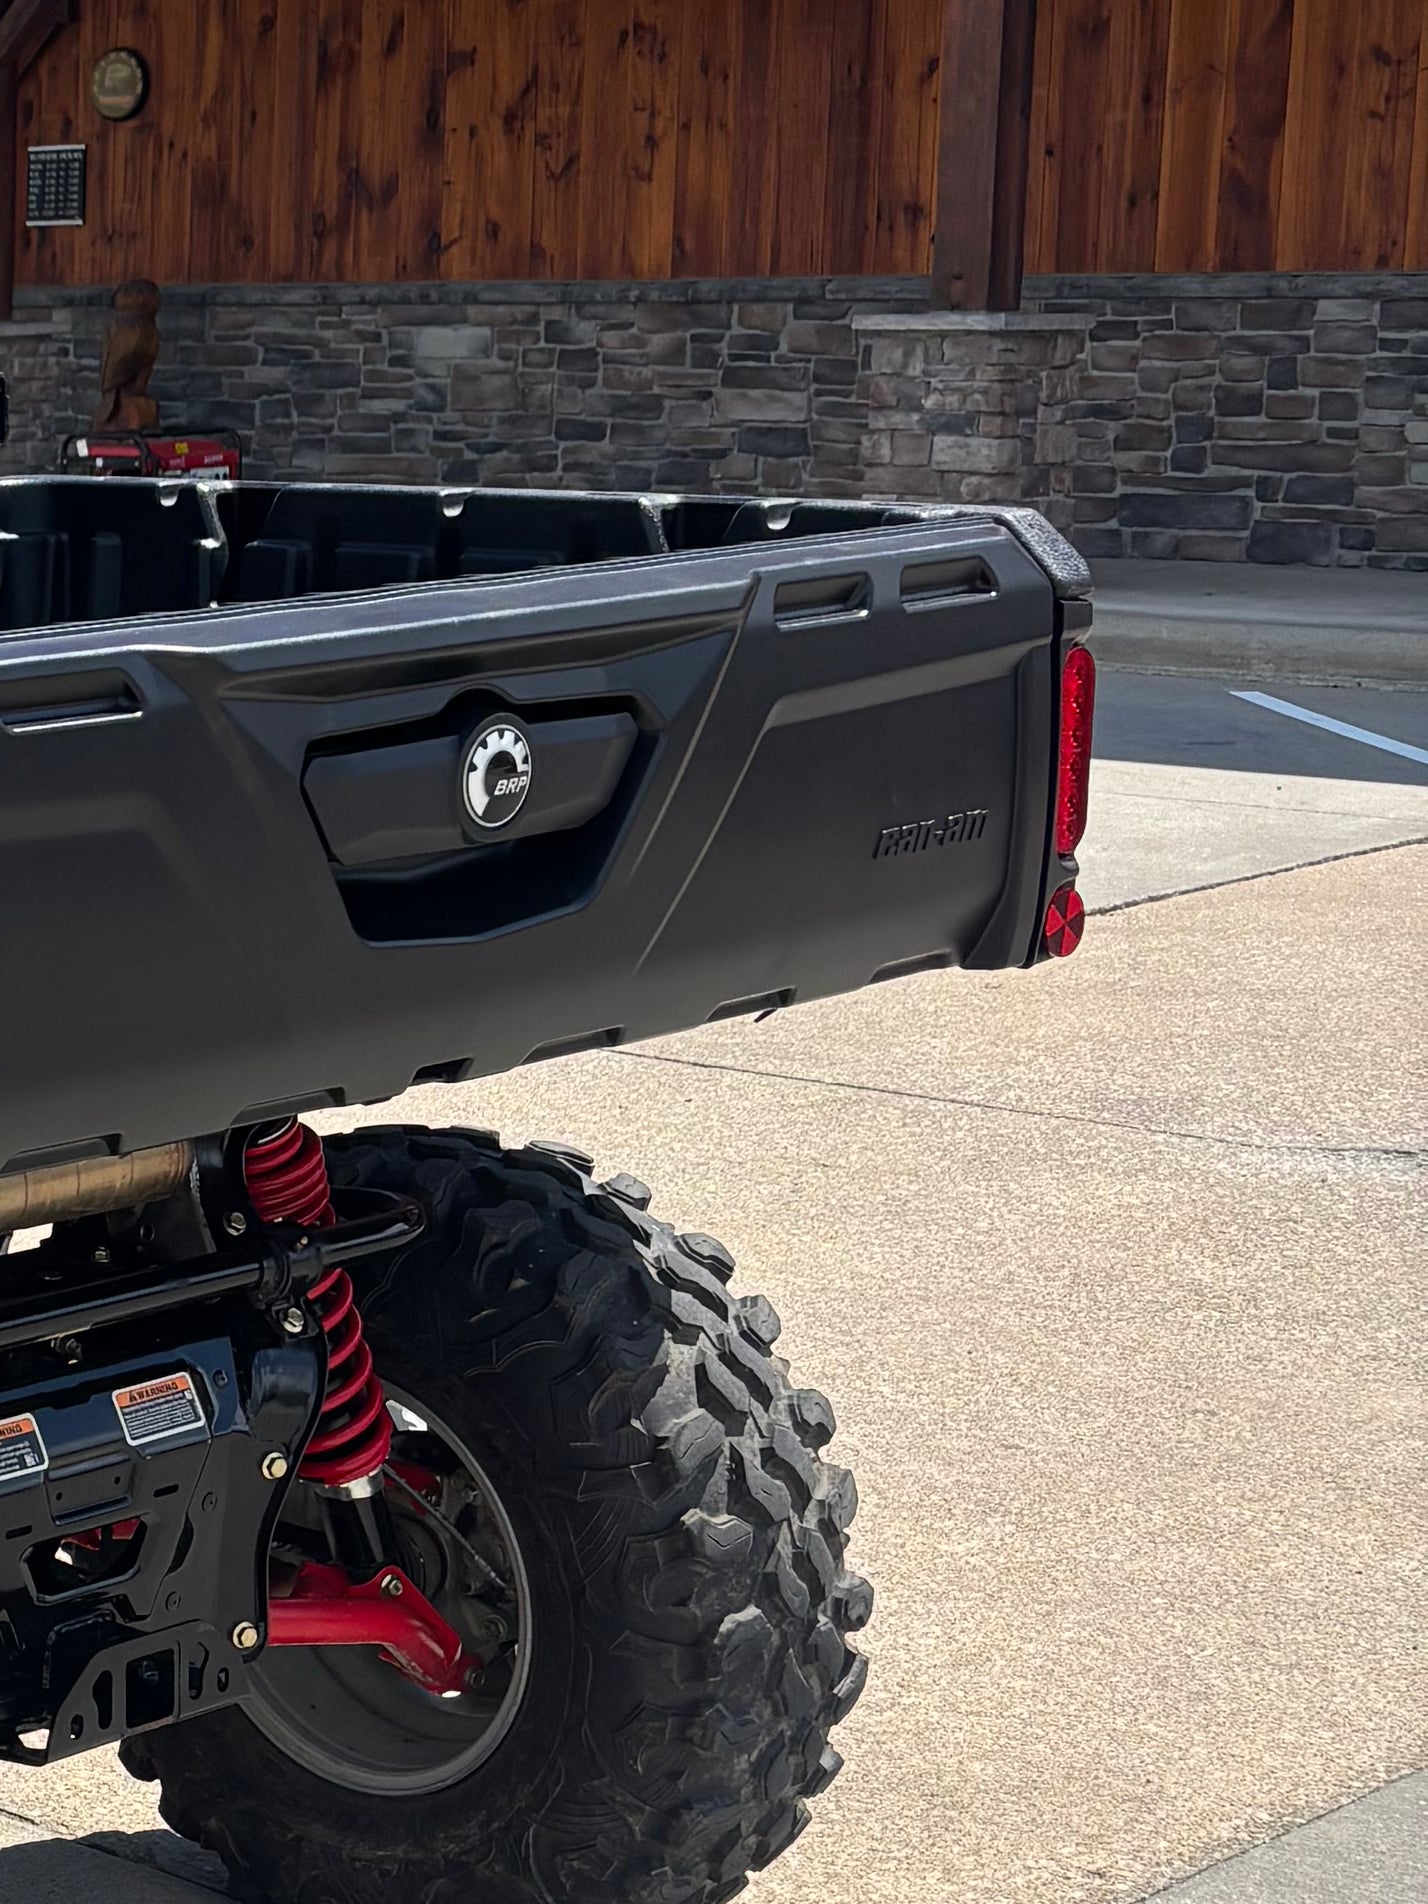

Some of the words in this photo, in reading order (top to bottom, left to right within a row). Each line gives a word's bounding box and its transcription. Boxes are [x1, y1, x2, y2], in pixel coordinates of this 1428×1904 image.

[494, 776, 528, 796] BRP
[872, 808, 990, 860] can-am
[136, 1381, 179, 1400] WARNING
